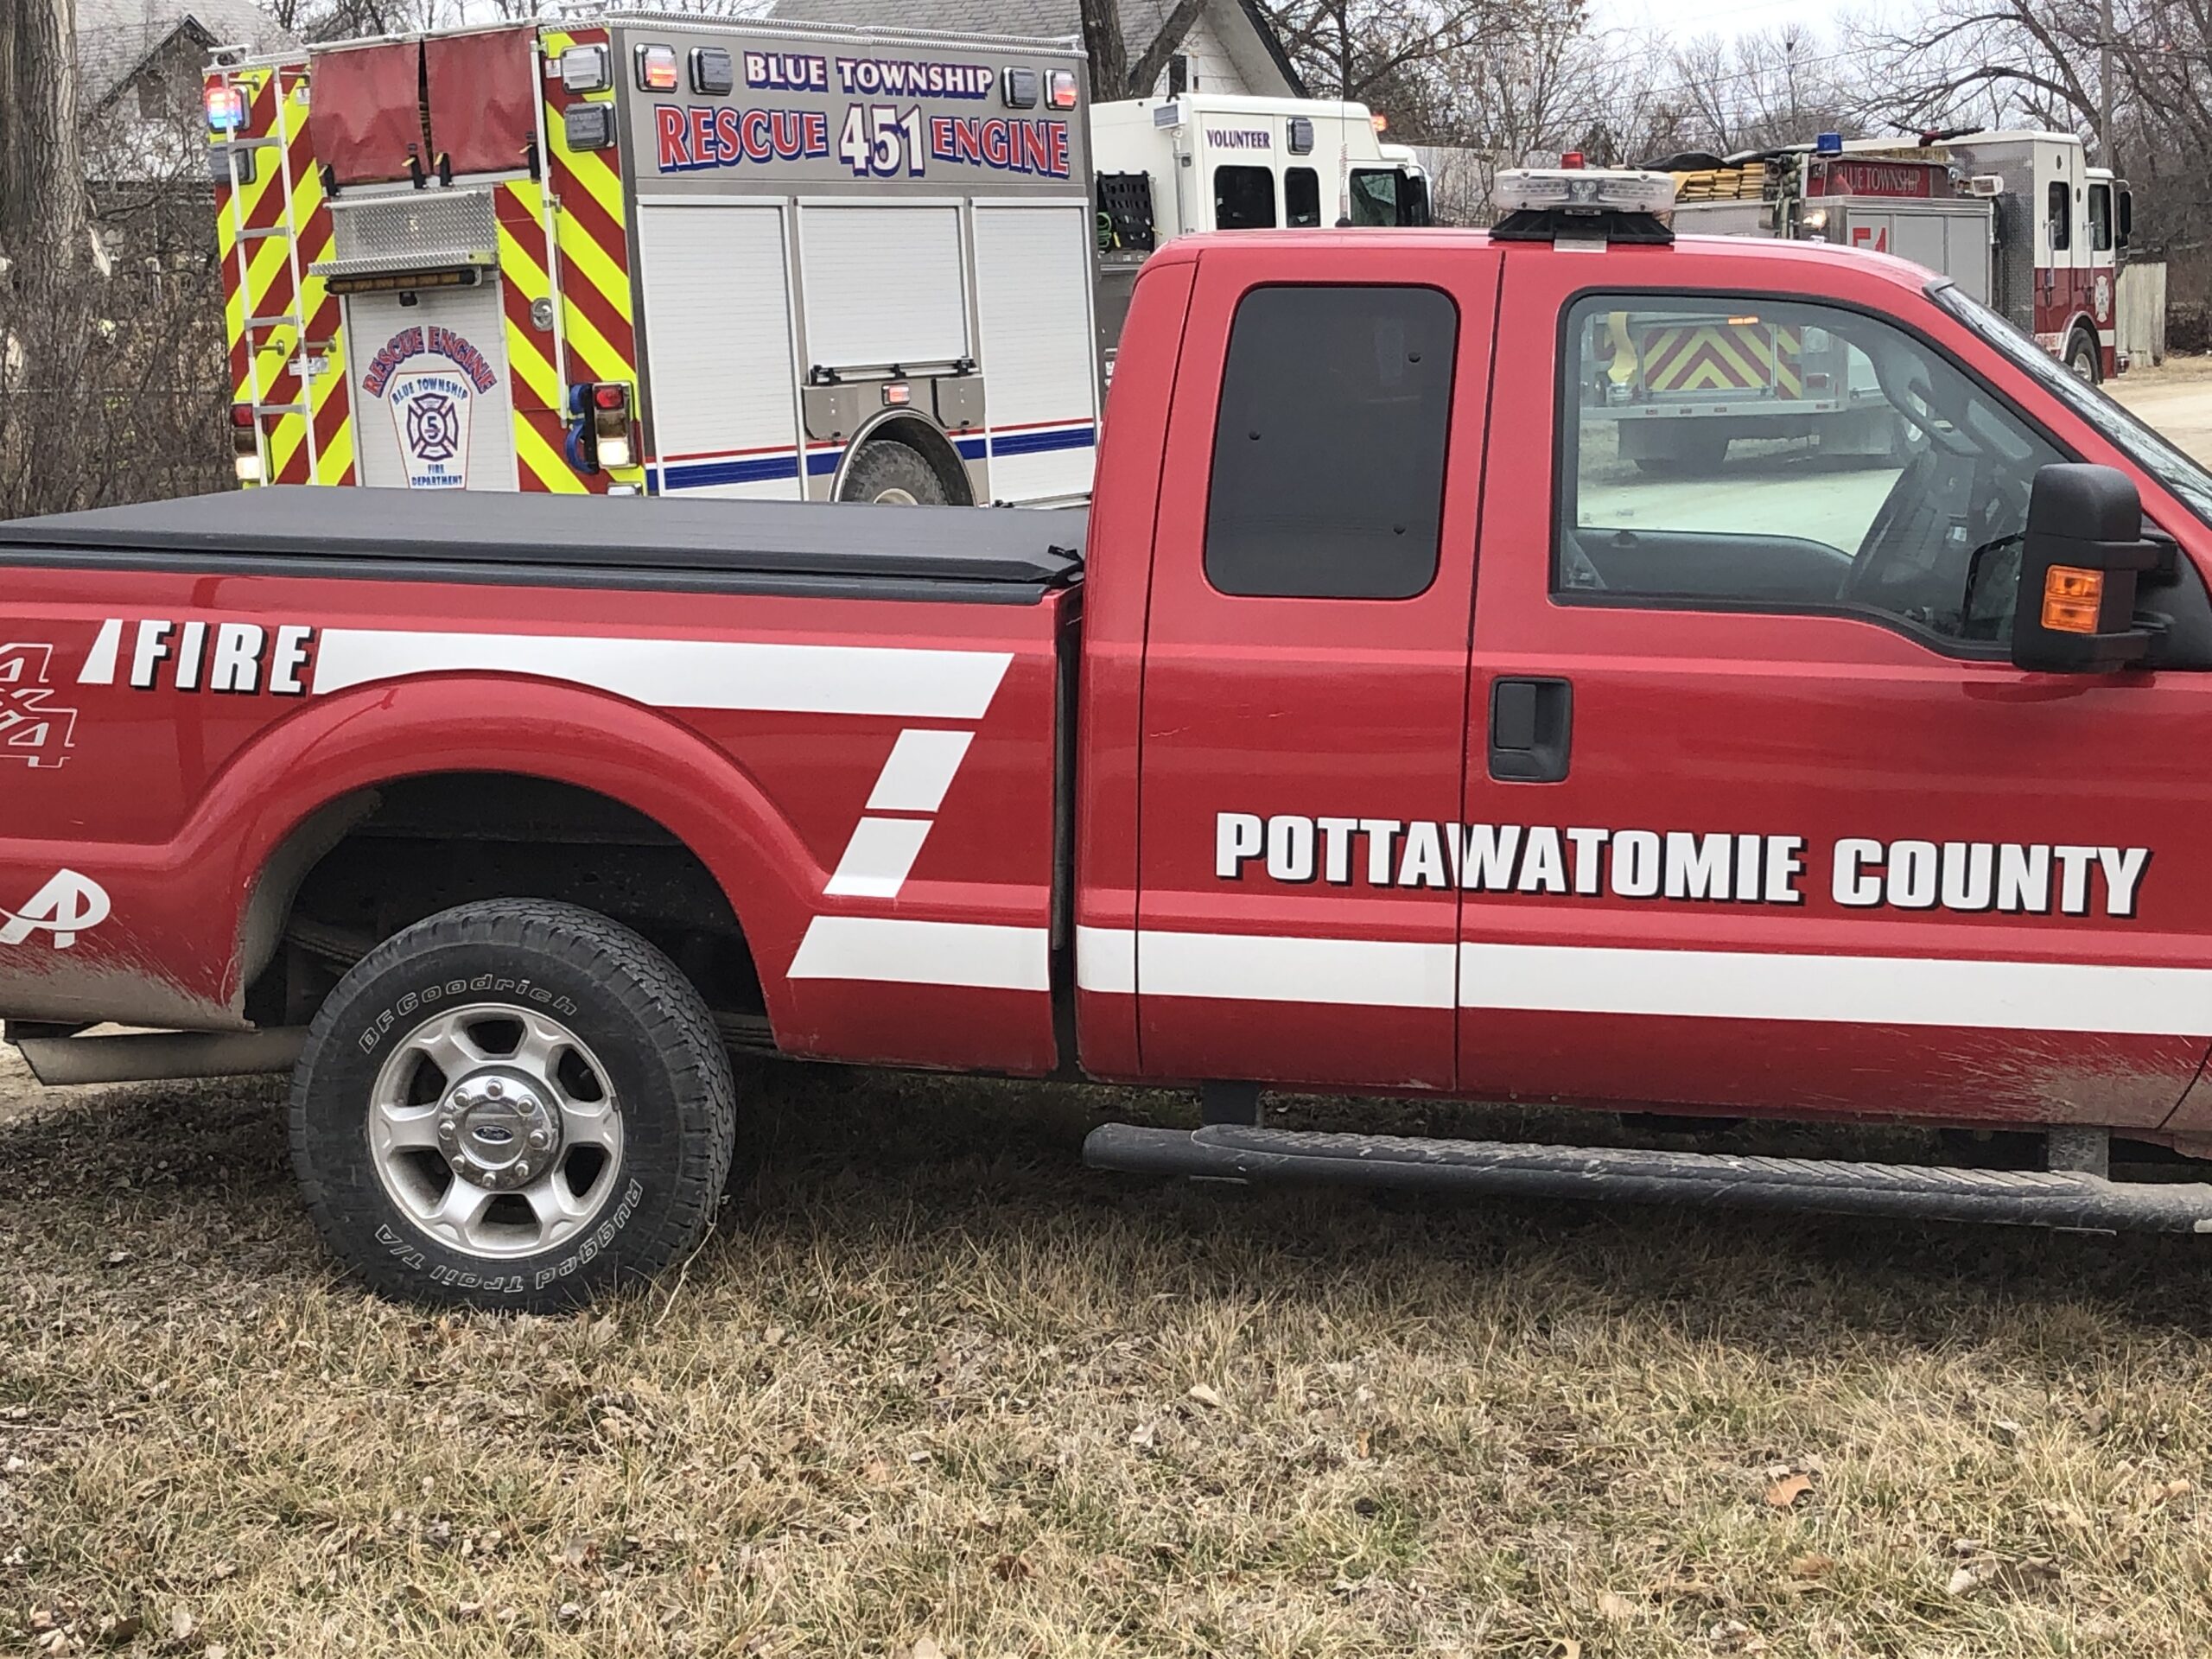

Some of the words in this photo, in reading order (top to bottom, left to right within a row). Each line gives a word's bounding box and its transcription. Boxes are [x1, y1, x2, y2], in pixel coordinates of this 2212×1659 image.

[744, 51, 829, 92] BLUE
[836, 57, 994, 99] TOWNSHIP
[654, 105, 830, 173] RESCUE
[838, 104, 926, 177] 451
[931, 117, 1071, 180] ENGINE
[1206, 129, 1271, 149] VOLUNTEER
[1866, 166, 1920, 194] TOWNSHIP
[362, 326, 425, 398] RESCUE
[428, 326, 498, 394] ENGINE
[391, 381, 415, 405] BLUE
[416, 378, 468, 400] TOWNSHIP
[411, 475, 463, 486] DEPARTMENT
[428, 463, 445, 474] FIRE
[130, 619, 315, 697] FIRE
[1213, 811, 1806, 906] POTTAWATOMIE
[1831, 837, 2153, 919] COUNTY
[374, 1223, 426, 1270] T/A
[536, 1179, 643, 1290] Rugged
[429, 1264, 524, 1294] Trail
